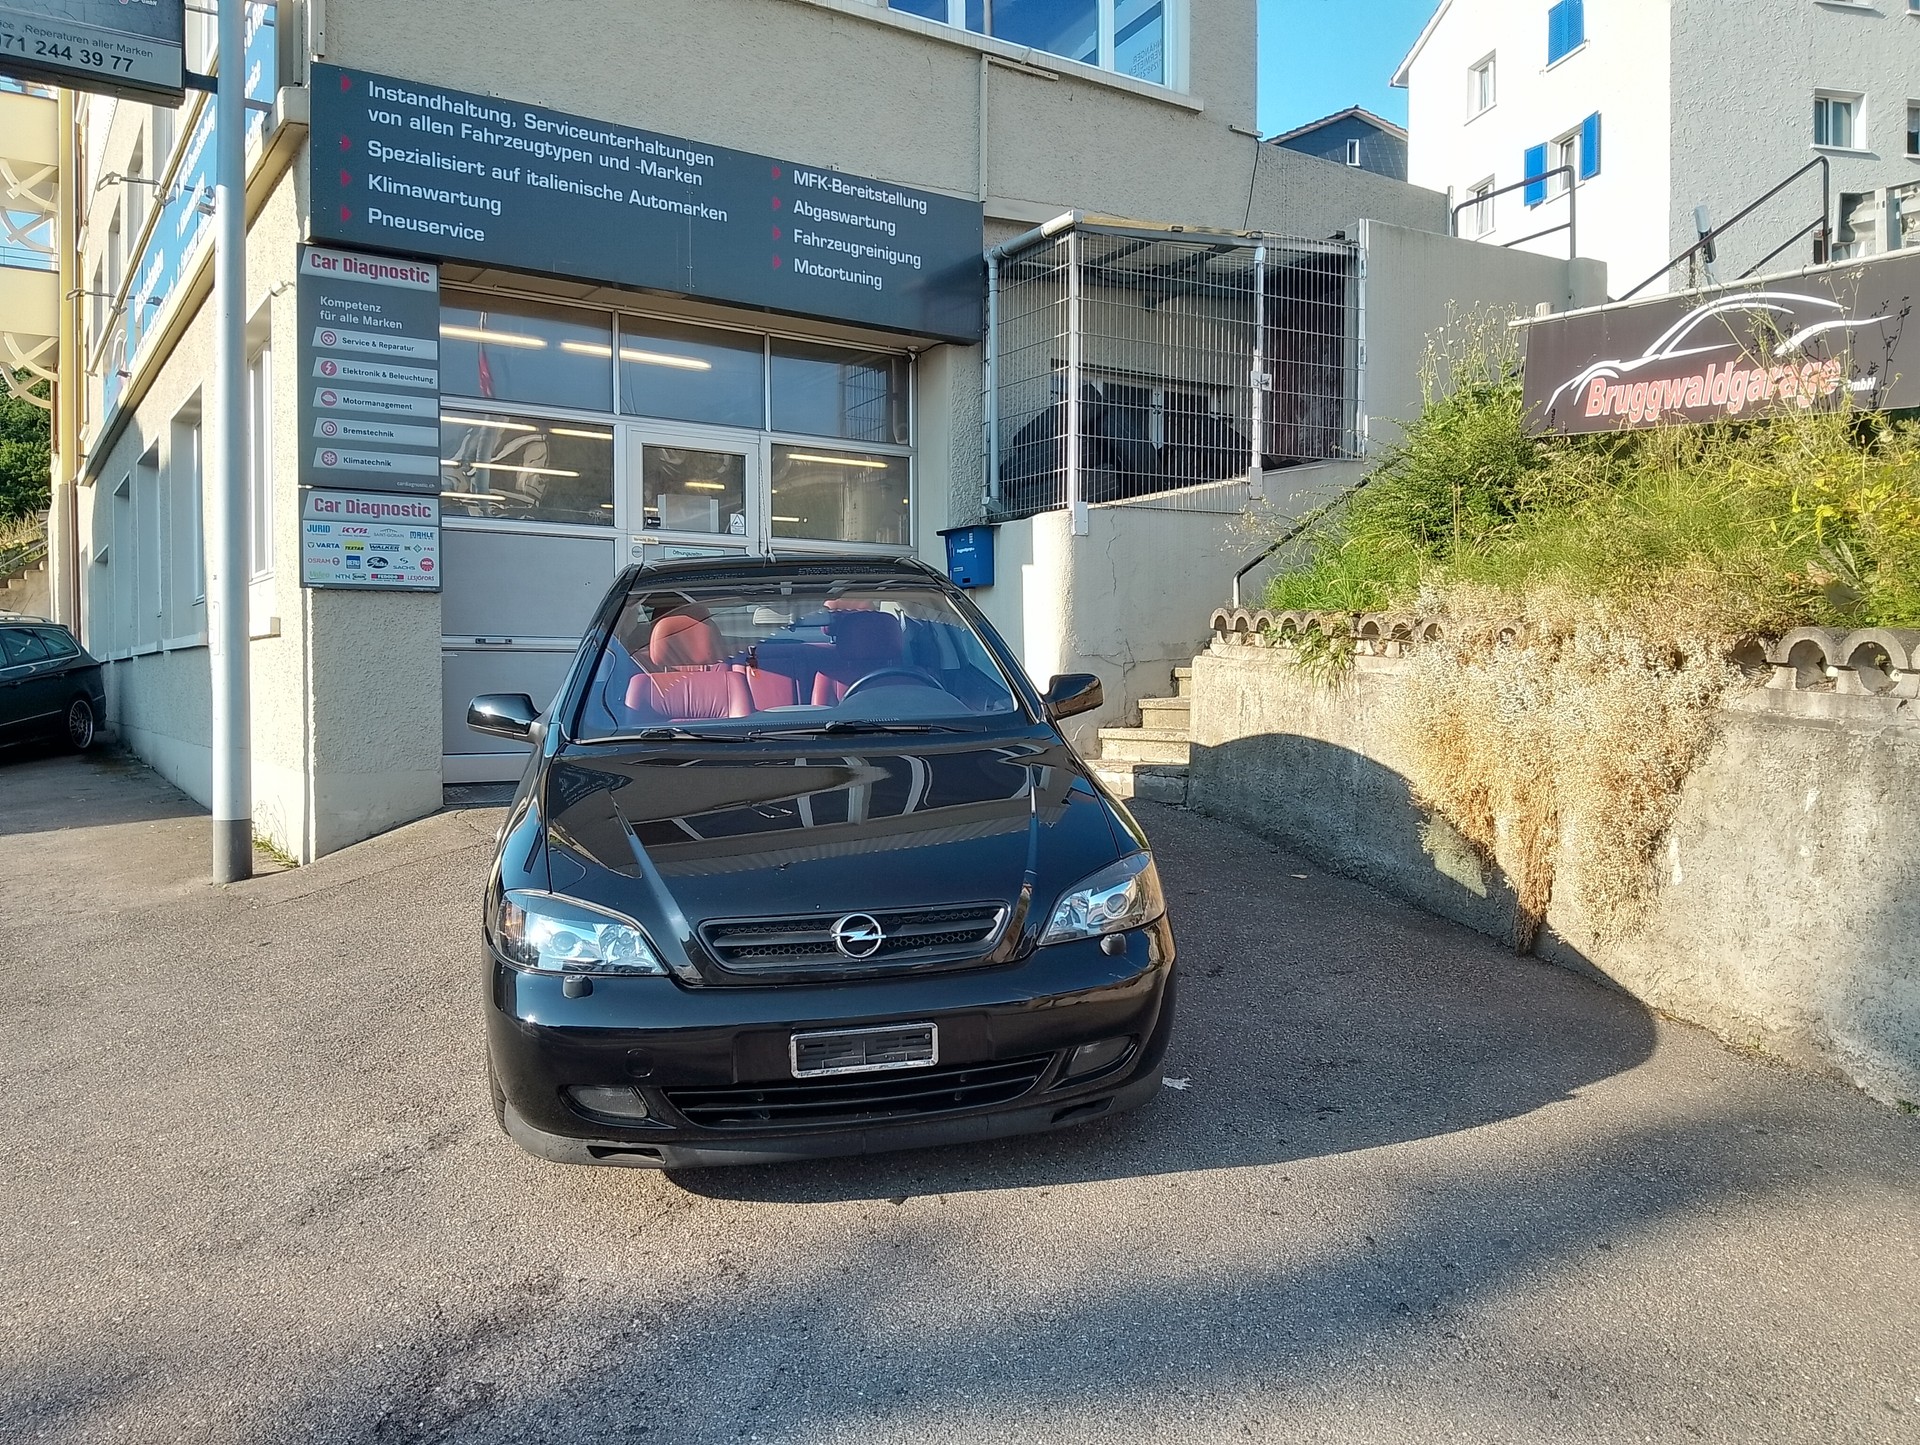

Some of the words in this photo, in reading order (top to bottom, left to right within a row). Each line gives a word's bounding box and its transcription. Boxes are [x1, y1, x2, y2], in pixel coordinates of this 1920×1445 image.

[0, 33, 26, 52] 71
[36, 40, 73, 61] 244
[80, 49, 103, 67] 39
[110, 55, 134, 73] 77
[92, 40, 114, 50] aller
[116, 43, 153, 58] Marken
[368, 81, 518, 130] Instandhaltung,
[524, 113, 715, 168] Serviceunterhaltungen
[368, 108, 402, 127] von
[409, 115, 454, 137] allen
[461, 124, 593, 164] Fahrzeugtypen
[599, 152, 630, 172] und
[635, 161, 703, 187] -Marken
[368, 140, 486, 177] Spezialisiert
[491, 165, 521, 184] auf
[527, 171, 624, 203] italienische
[629, 189, 728, 222] Automarken
[368, 174, 502, 216] Klimawartung
[793, 170, 928, 215] MFK-Bereitstellung
[368, 207, 485, 242] Pneuservice
[793, 200, 897, 237] Abgaswartung
[793, 228, 922, 270] Fahrzeugreinigung
[311, 253, 339, 271] Car
[343, 257, 430, 284] Diagnostic
[793, 258, 883, 291] Motortuning
[320, 296, 382, 313] Kompetenz
[320, 310, 336, 321] für
[340, 313, 359, 324] alle
[362, 316, 403, 329] Marken
[342, 337, 370, 347] Service
[379, 341, 414, 352] Reparatur
[342, 366, 380, 378] Elektronik
[389, 371, 434, 384] Beleuchtung
[343, 396, 413, 411] Motormanagement
[1585, 359, 1841, 423] Bruggwaldgarage
[343, 426, 395, 438] Bremstechnik
[343, 456, 392, 467] Klimatechnik
[314, 497, 341, 513] Car
[346, 499, 432, 519] Diagnostic
[307, 524, 331, 533] JURID
[410, 531, 435, 540] MAHLE
